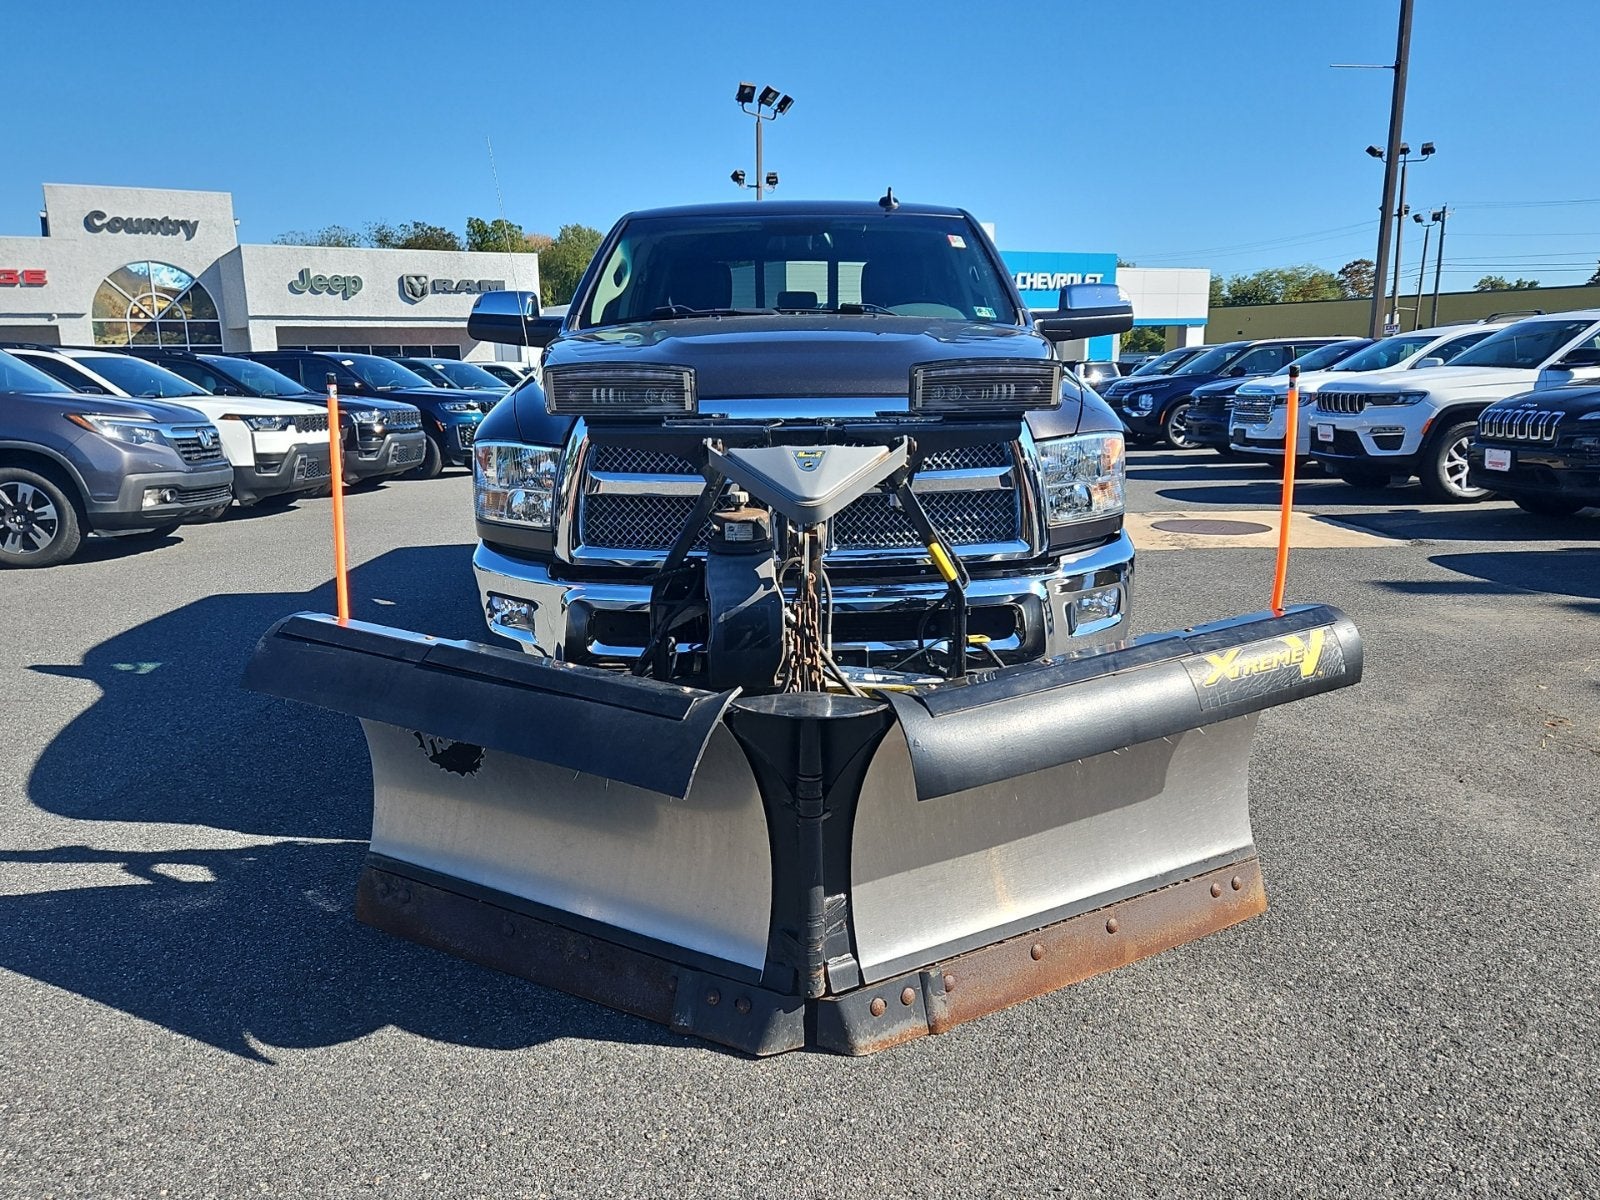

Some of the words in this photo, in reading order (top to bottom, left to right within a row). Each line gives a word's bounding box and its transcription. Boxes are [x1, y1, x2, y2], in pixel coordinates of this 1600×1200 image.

[83, 210, 199, 241] Country
[288, 267, 363, 301] Jeep
[430, 279, 505, 295] RAM
[1016, 272, 1104, 290] CHEVROLET
